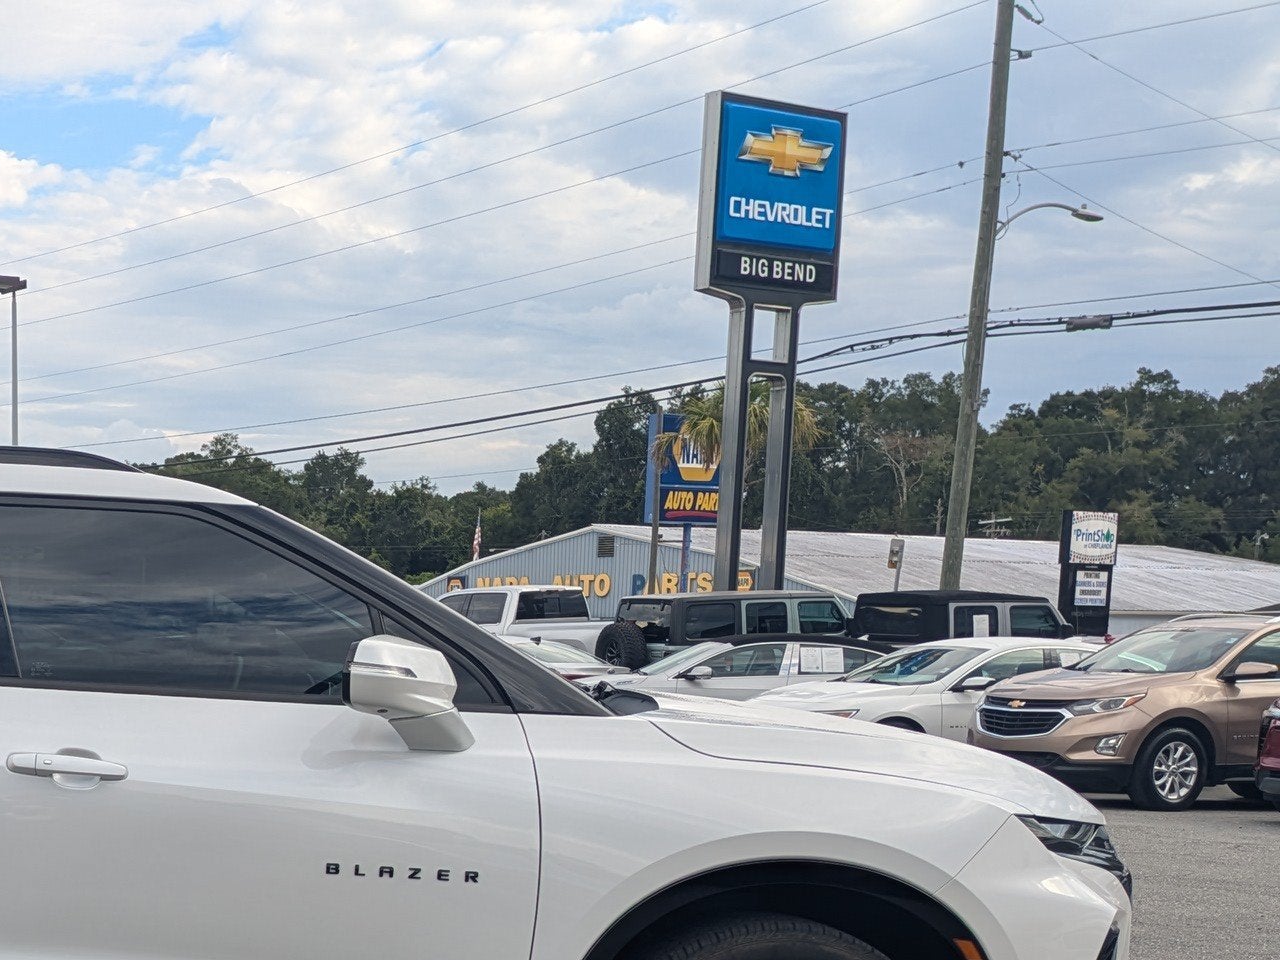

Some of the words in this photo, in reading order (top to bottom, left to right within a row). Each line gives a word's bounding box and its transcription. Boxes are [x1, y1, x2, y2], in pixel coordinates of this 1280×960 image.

[729, 196, 834, 228] CHEVROLET
[740, 256, 768, 277] BIG
[773, 260, 816, 283] BEND
[664, 490, 694, 511] AUTO
[325, 862, 479, 883] BLAZER
